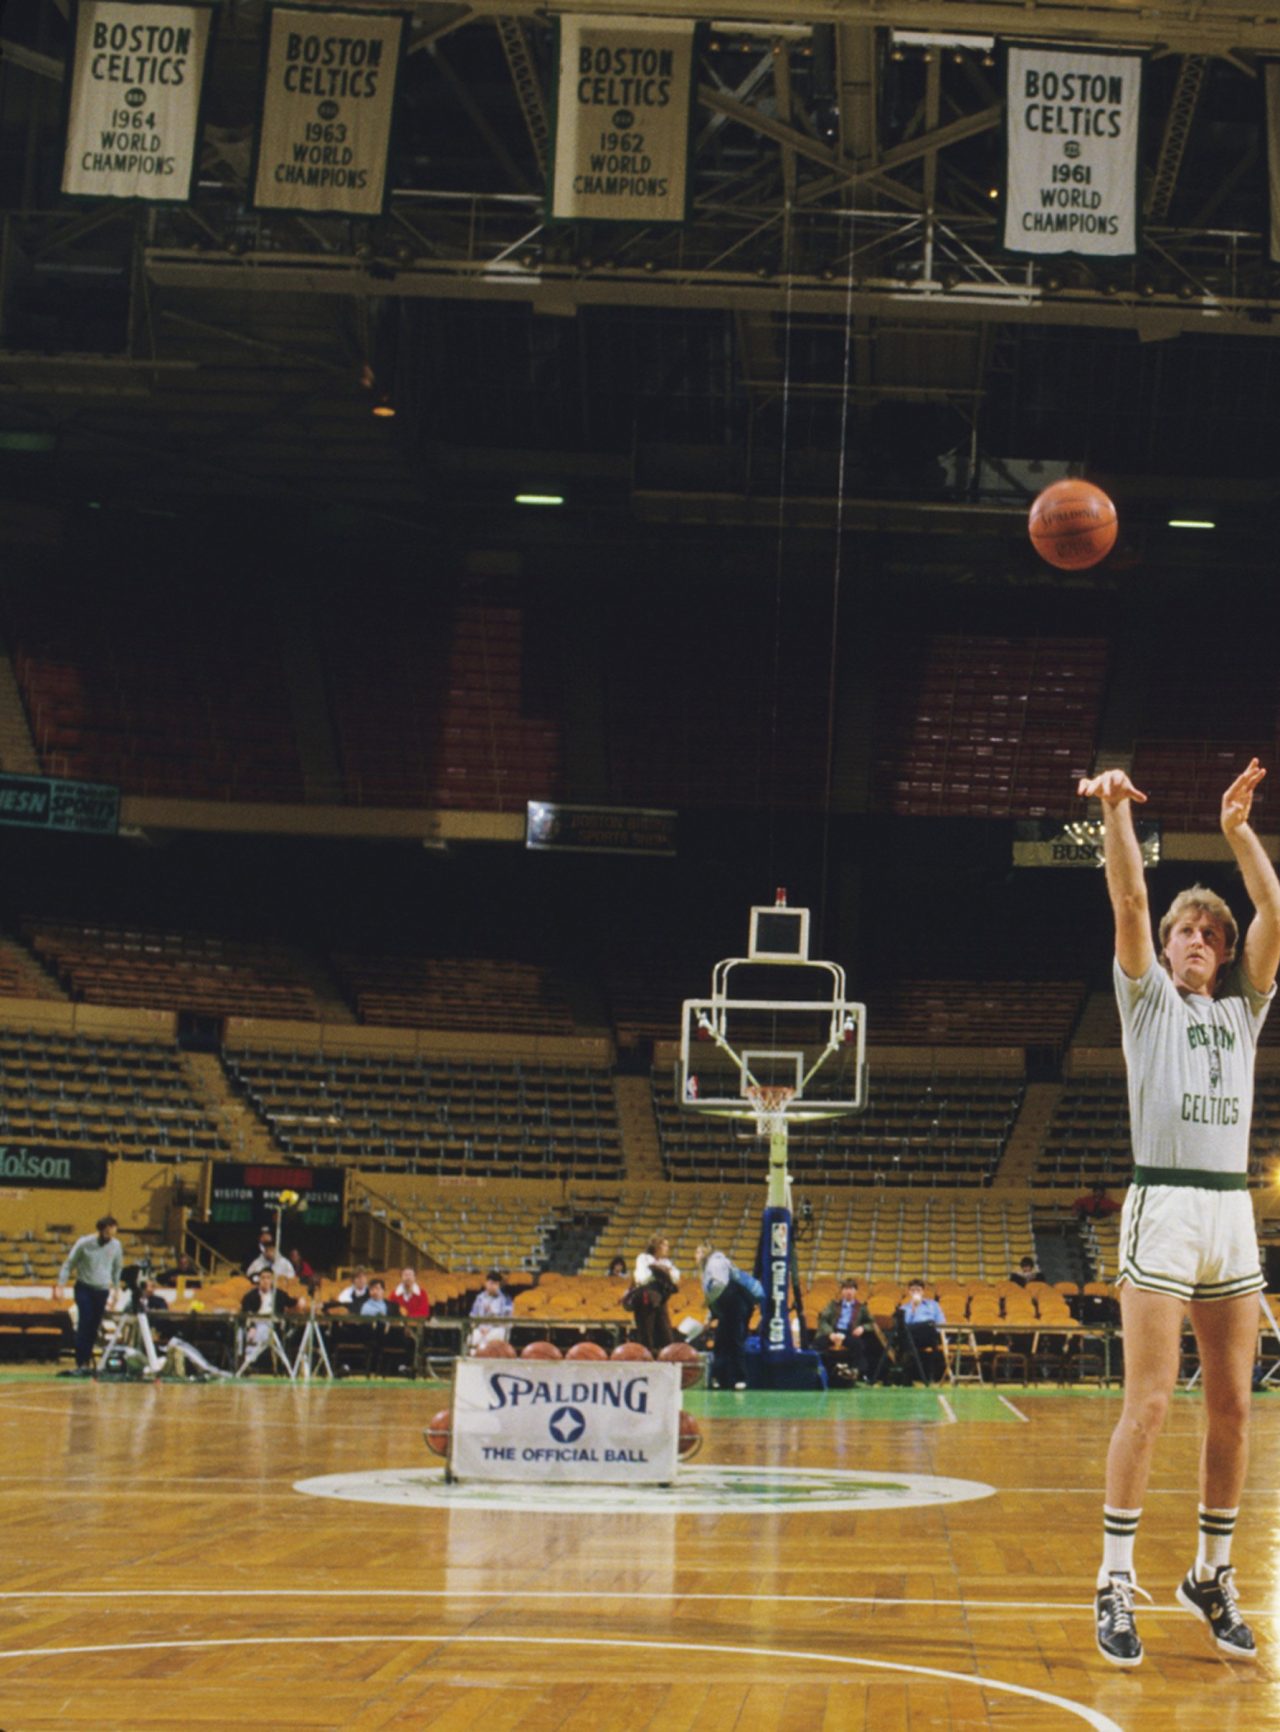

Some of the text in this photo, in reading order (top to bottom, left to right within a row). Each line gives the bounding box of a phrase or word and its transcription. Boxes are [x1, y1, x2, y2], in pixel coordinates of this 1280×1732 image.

[93, 22, 191, 55] BOSTON
[286, 32, 383, 67] BOSTON
[91, 54, 186, 86] CELTICS
[579, 46, 673, 77] BOSTON
[284, 65, 378, 98] CELTICS
[577, 77, 670, 107] CELTICS
[1025, 70, 1122, 104] BOSTON
[112, 110, 156, 130] 1964
[1025, 103, 1121, 138] CELTICS
[101, 131, 161, 153] WORLD
[305, 123, 347, 143] 1963
[601, 133, 644, 152] 1962
[82, 152, 174, 175] CHAMPIONS
[293, 144, 353, 166] WORLD
[590, 155, 651, 174] WORLD
[275, 164, 368, 188] CHAMPIONS
[1052, 164, 1091, 184] 1961
[573, 175, 668, 197] CHAMPIONS
[1040, 188, 1102, 209] WORLD
[1022, 212, 1119, 235] CHAMPIONS
[1181, 1093, 1239, 1126] CELTICS
[214, 1188, 253, 1199] VISITOR
[489, 1373, 648, 1414] SPALDING
[482, 1447, 648, 1462] THE OFFICIAL BALL
